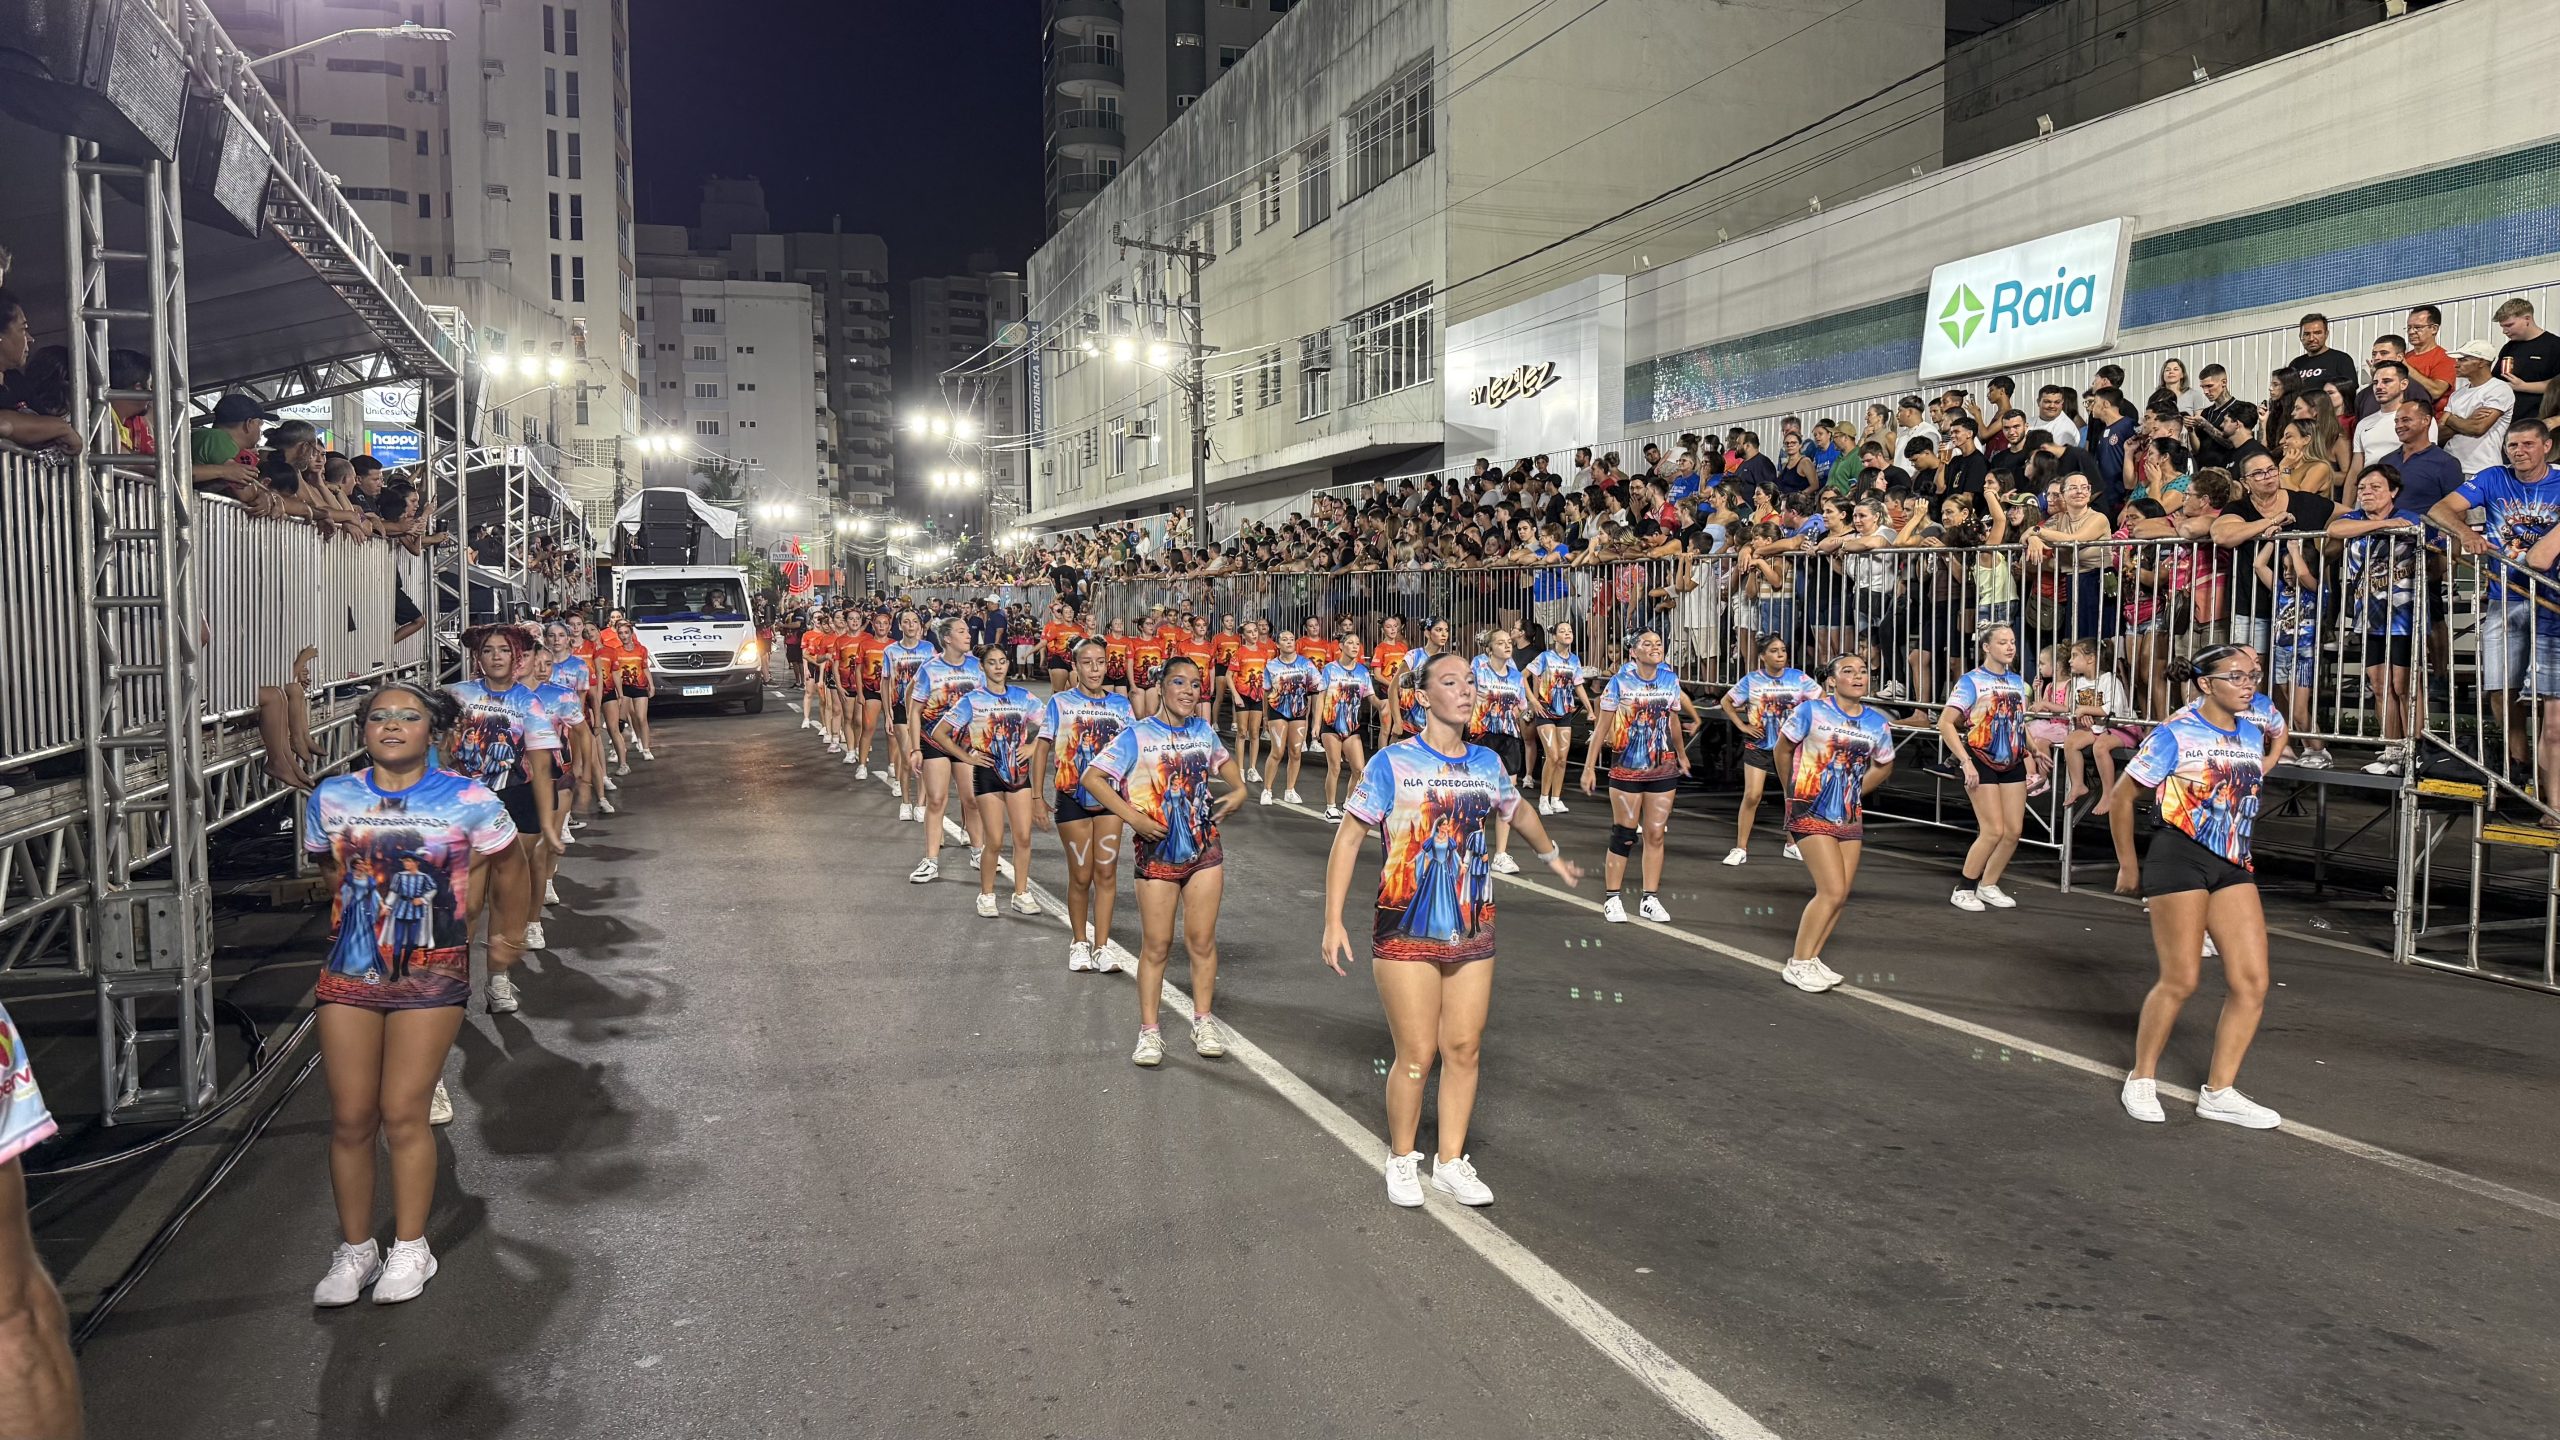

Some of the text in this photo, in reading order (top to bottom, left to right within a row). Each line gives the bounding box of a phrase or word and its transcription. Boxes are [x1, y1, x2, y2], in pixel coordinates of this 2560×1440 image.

[1989, 266, 2096, 333] Raia
[1031, 324, 1040, 361] SOCIAL
[2299, 368, 2323, 378] UGO
[1470, 386, 1487, 405] BY
[372, 432, 418, 445] happy
[663, 634, 722, 642] Roncen
[2185, 749, 2204, 758] ALA
[1403, 778, 1424, 788] ALA
